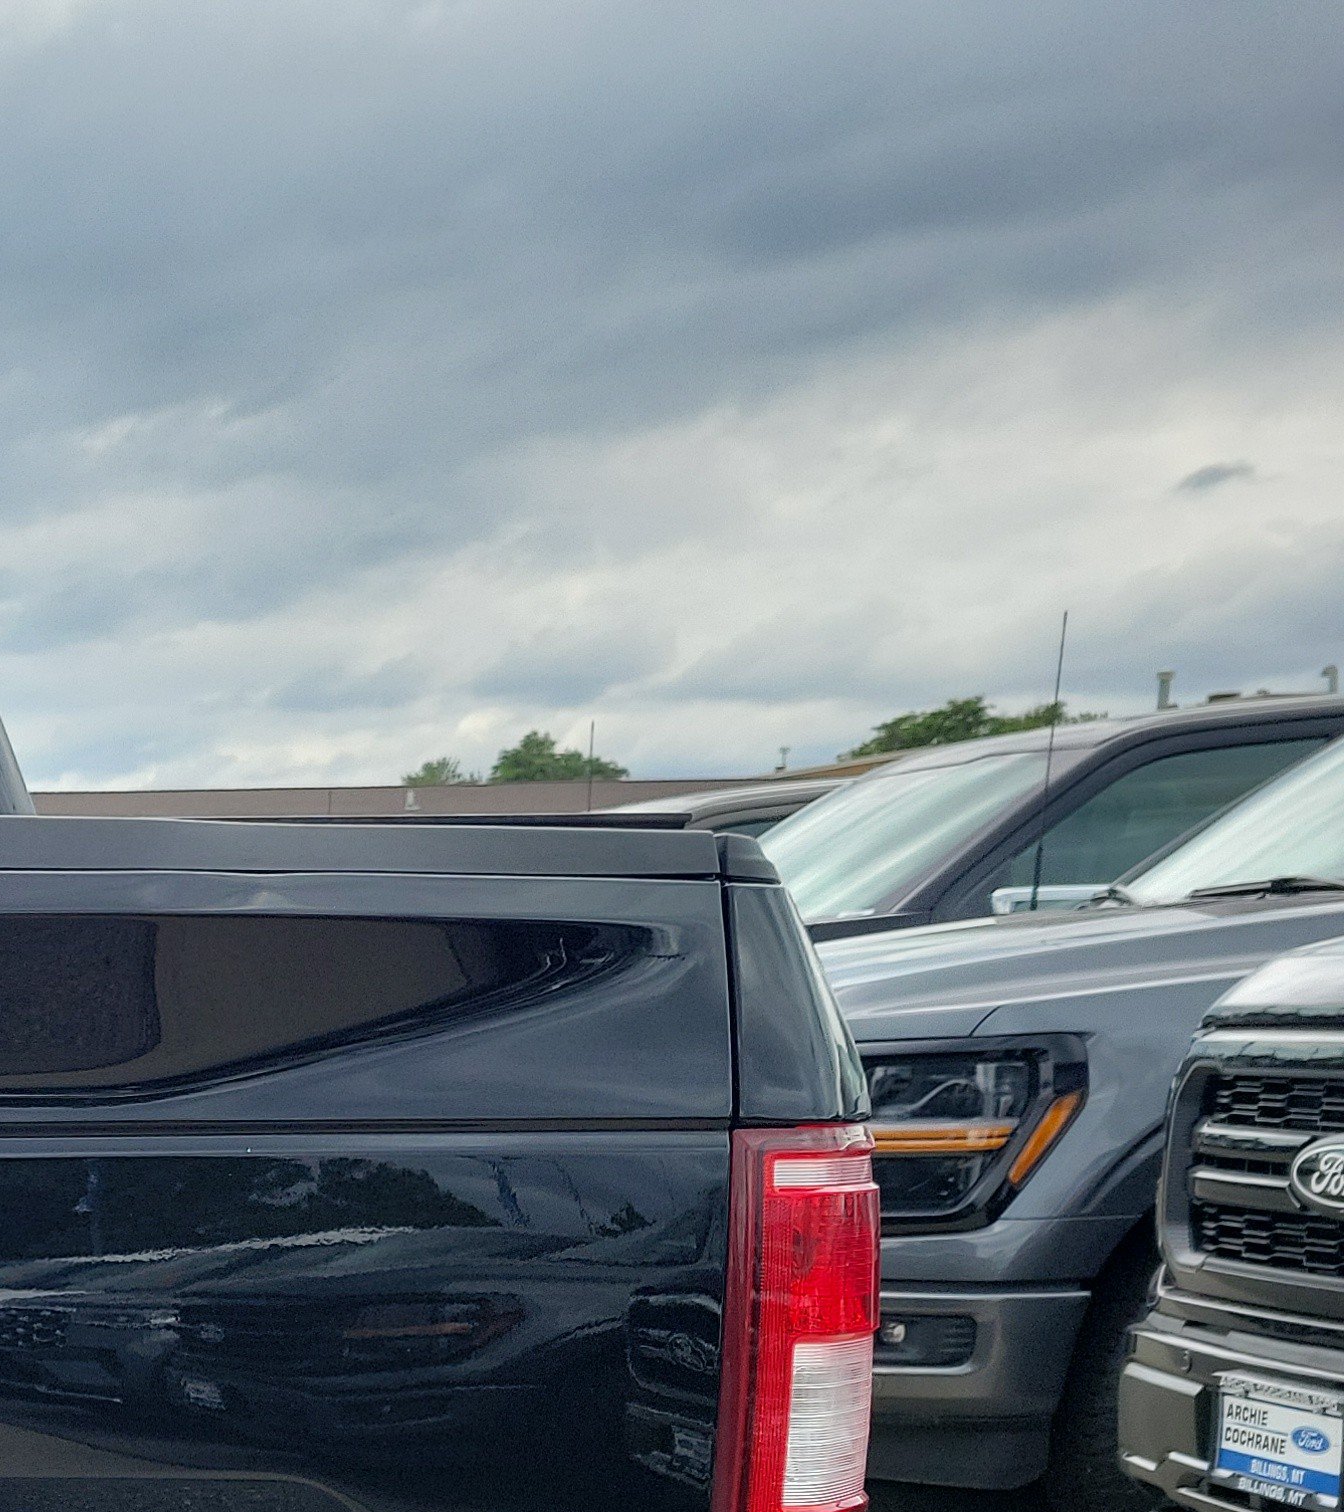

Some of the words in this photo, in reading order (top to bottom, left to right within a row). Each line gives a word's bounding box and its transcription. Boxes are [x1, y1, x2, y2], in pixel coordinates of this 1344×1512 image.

[1226, 1403, 1269, 1426] ARCHIE
[1224, 1427, 1287, 1455] COCHRANE
[1298, 1429, 1323, 1450] Ford
[1291, 1470, 1306, 1485] MT
[1289, 1490, 1308, 1507] MT
